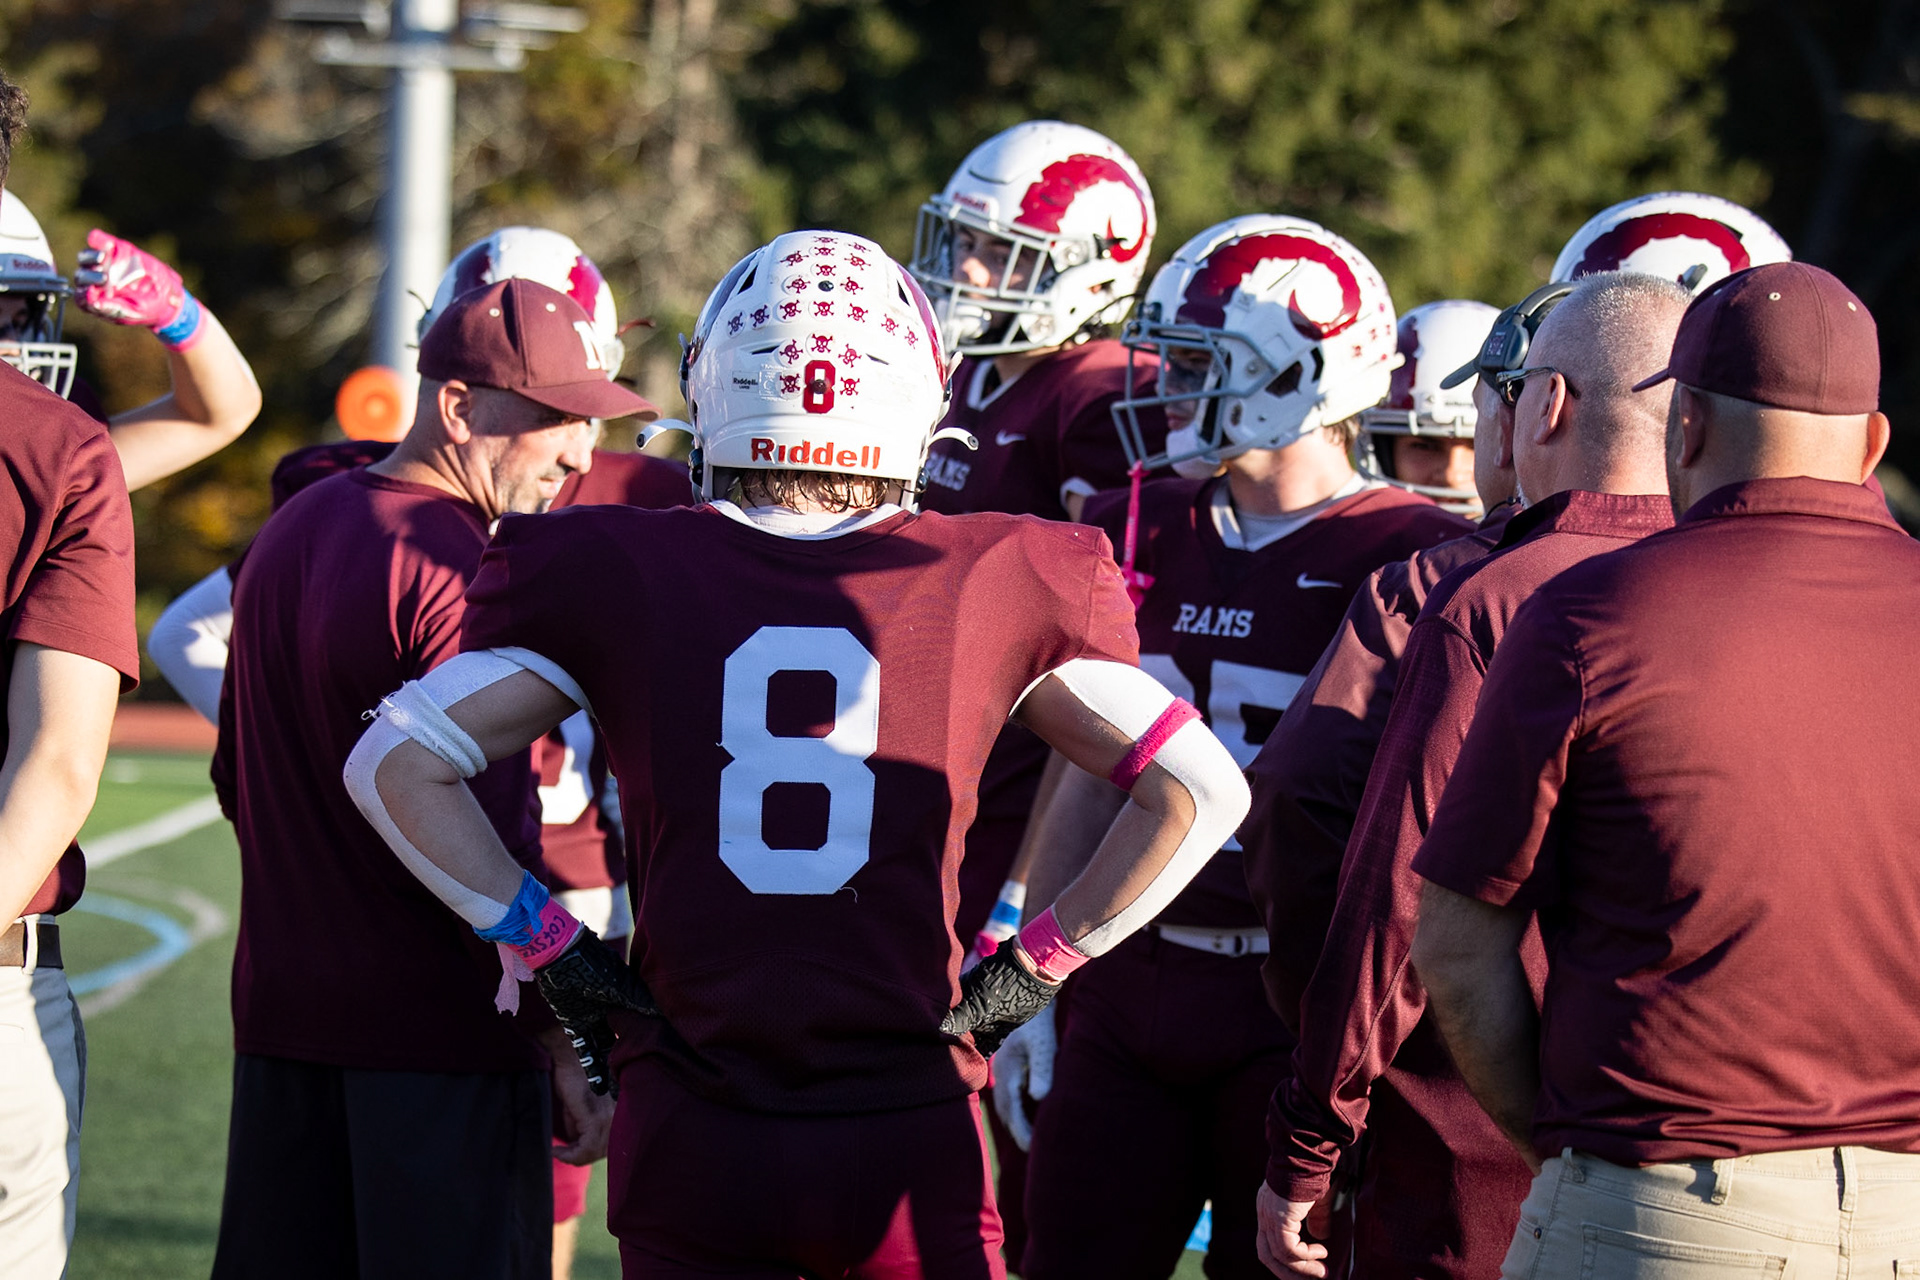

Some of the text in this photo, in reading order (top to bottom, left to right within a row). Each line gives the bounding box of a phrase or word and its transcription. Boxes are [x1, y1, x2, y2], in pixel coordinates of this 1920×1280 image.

[803, 360, 836, 414] 8
[751, 437, 881, 470] Riddell
[1172, 603, 1254, 638] RAMS
[718, 625, 881, 895] 8
